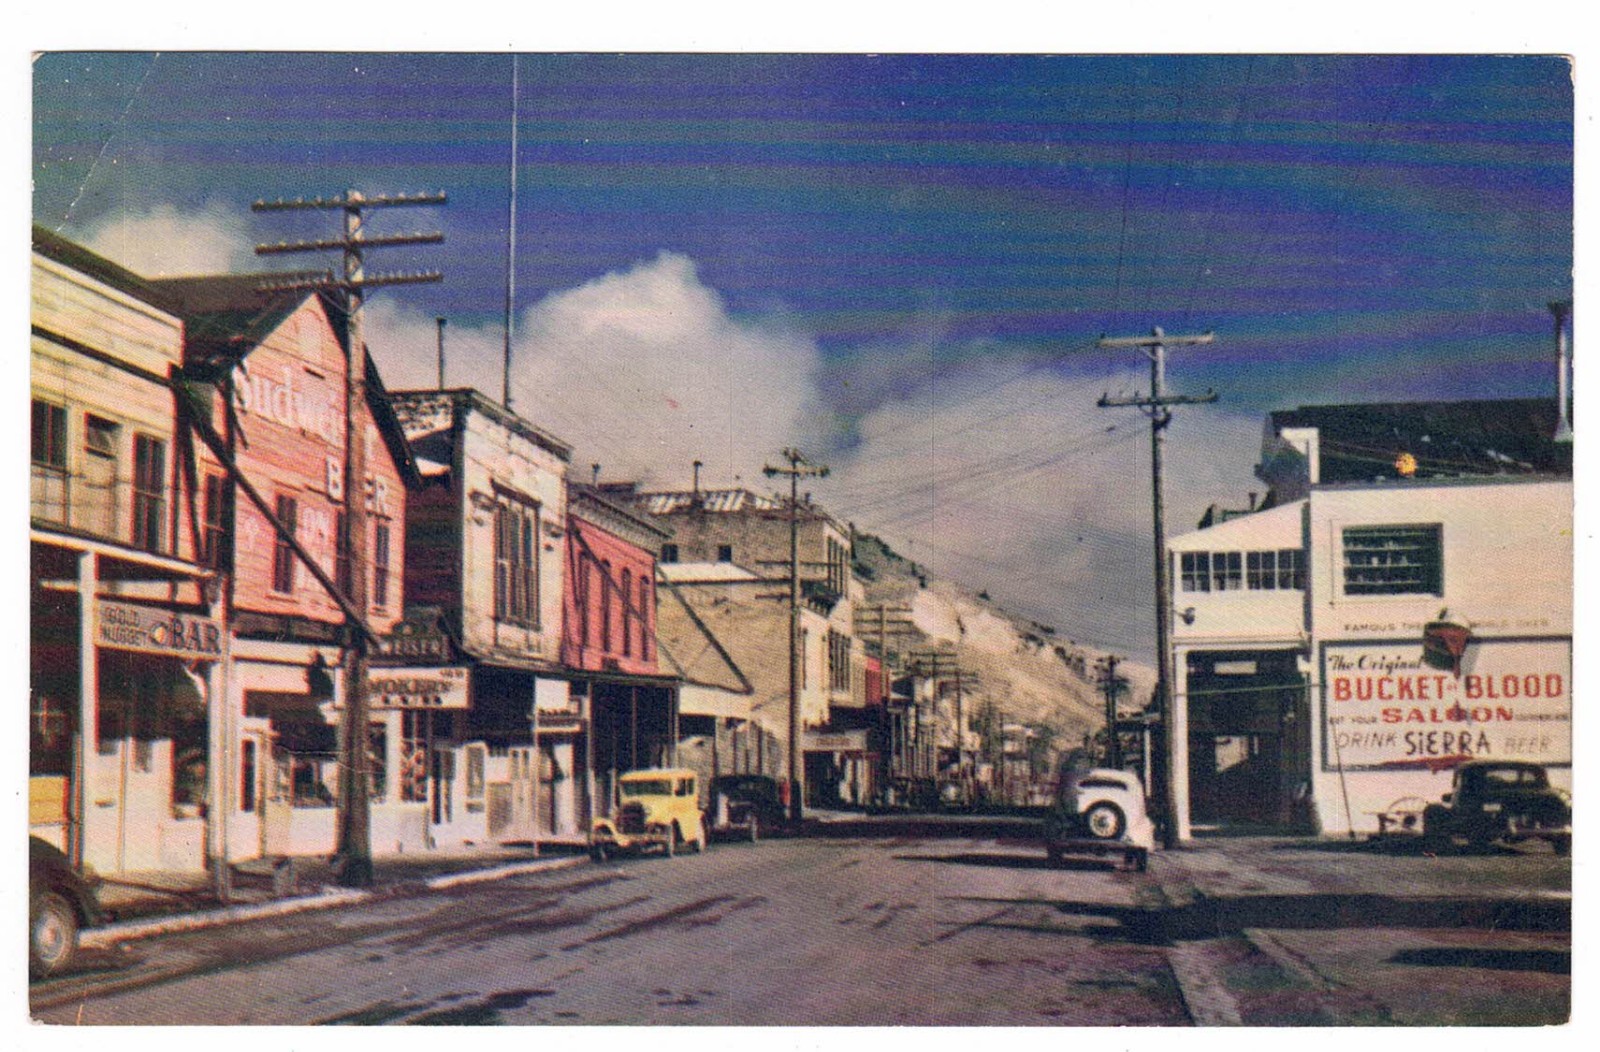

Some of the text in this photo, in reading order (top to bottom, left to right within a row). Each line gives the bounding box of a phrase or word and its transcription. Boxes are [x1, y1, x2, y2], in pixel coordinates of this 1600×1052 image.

[168, 616, 222, 654] BAR
[1343, 622, 1396, 632] FAMOUS
[1328, 654, 1422, 675] The Original
[1333, 675, 1447, 701] BUCKET
[1465, 673, 1564, 699] BLOOD
[1382, 706, 1514, 723] SALOON
[1337, 731, 1397, 748] DRINK
